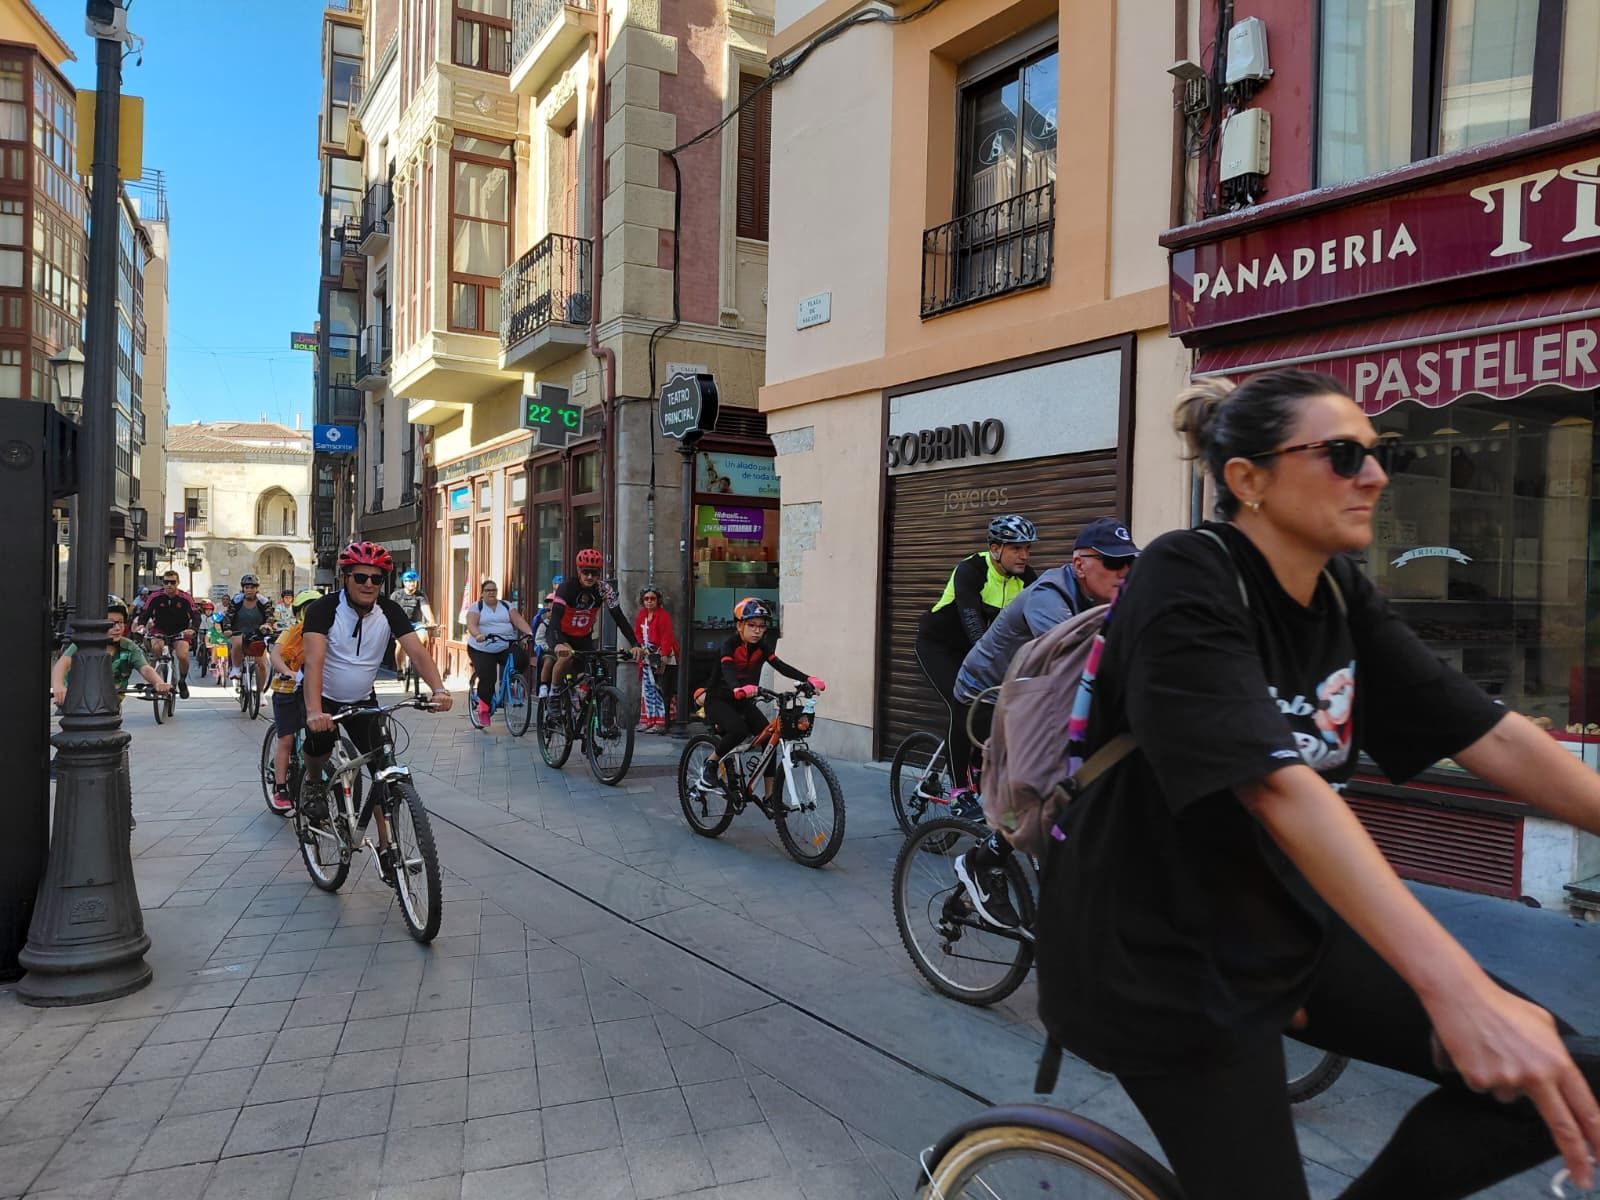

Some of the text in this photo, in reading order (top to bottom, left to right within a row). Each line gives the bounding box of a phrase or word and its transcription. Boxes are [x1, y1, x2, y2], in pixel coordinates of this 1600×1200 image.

[1193, 222, 1417, 303] PANADERIA
[667, 388, 689, 405] TEATRO
[528, 404, 578, 427] 22 °C
[664, 407, 694, 425] PRINCIPAL
[887, 418, 1005, 468] SOBRINO
[943, 487, 1009, 513] joyeros
